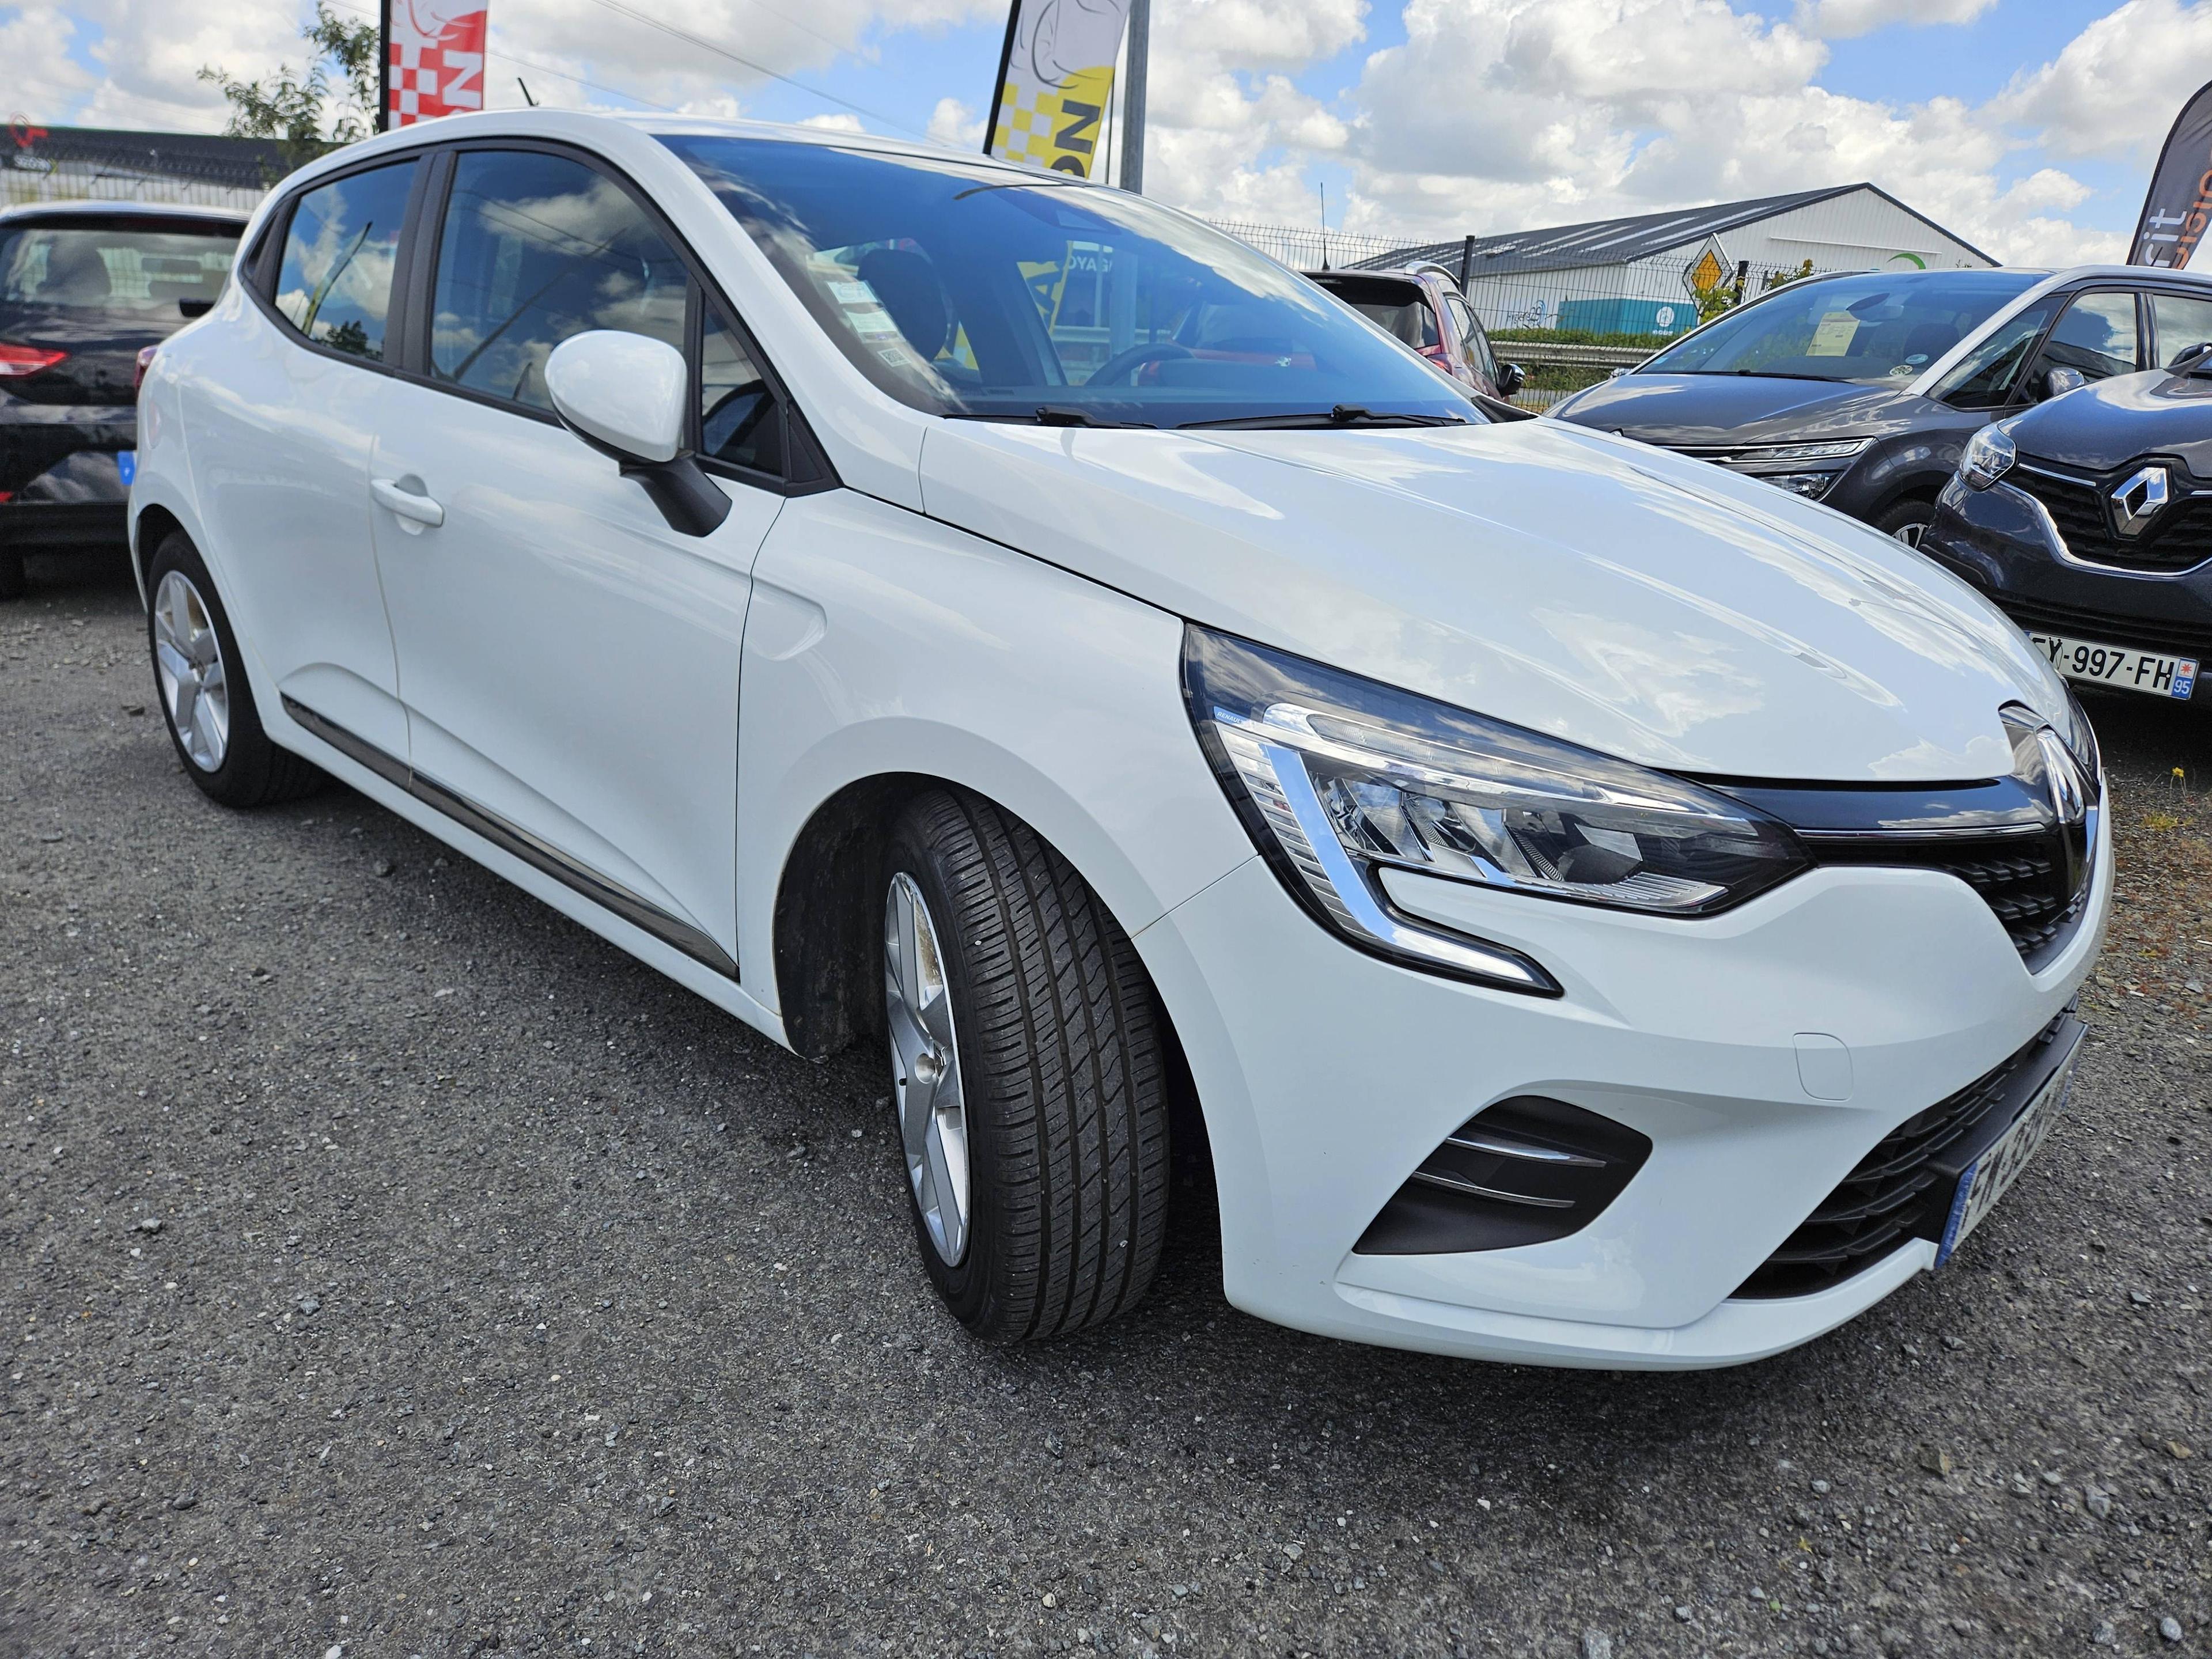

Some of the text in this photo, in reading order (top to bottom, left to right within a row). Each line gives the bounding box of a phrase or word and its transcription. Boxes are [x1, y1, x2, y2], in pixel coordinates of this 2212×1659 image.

[442, 49, 482, 115] N
[1069, 255, 1112, 272] OYAG
[2173, 680, 2191, 694] 95
[1217, 711, 1244, 724] RENAUL
